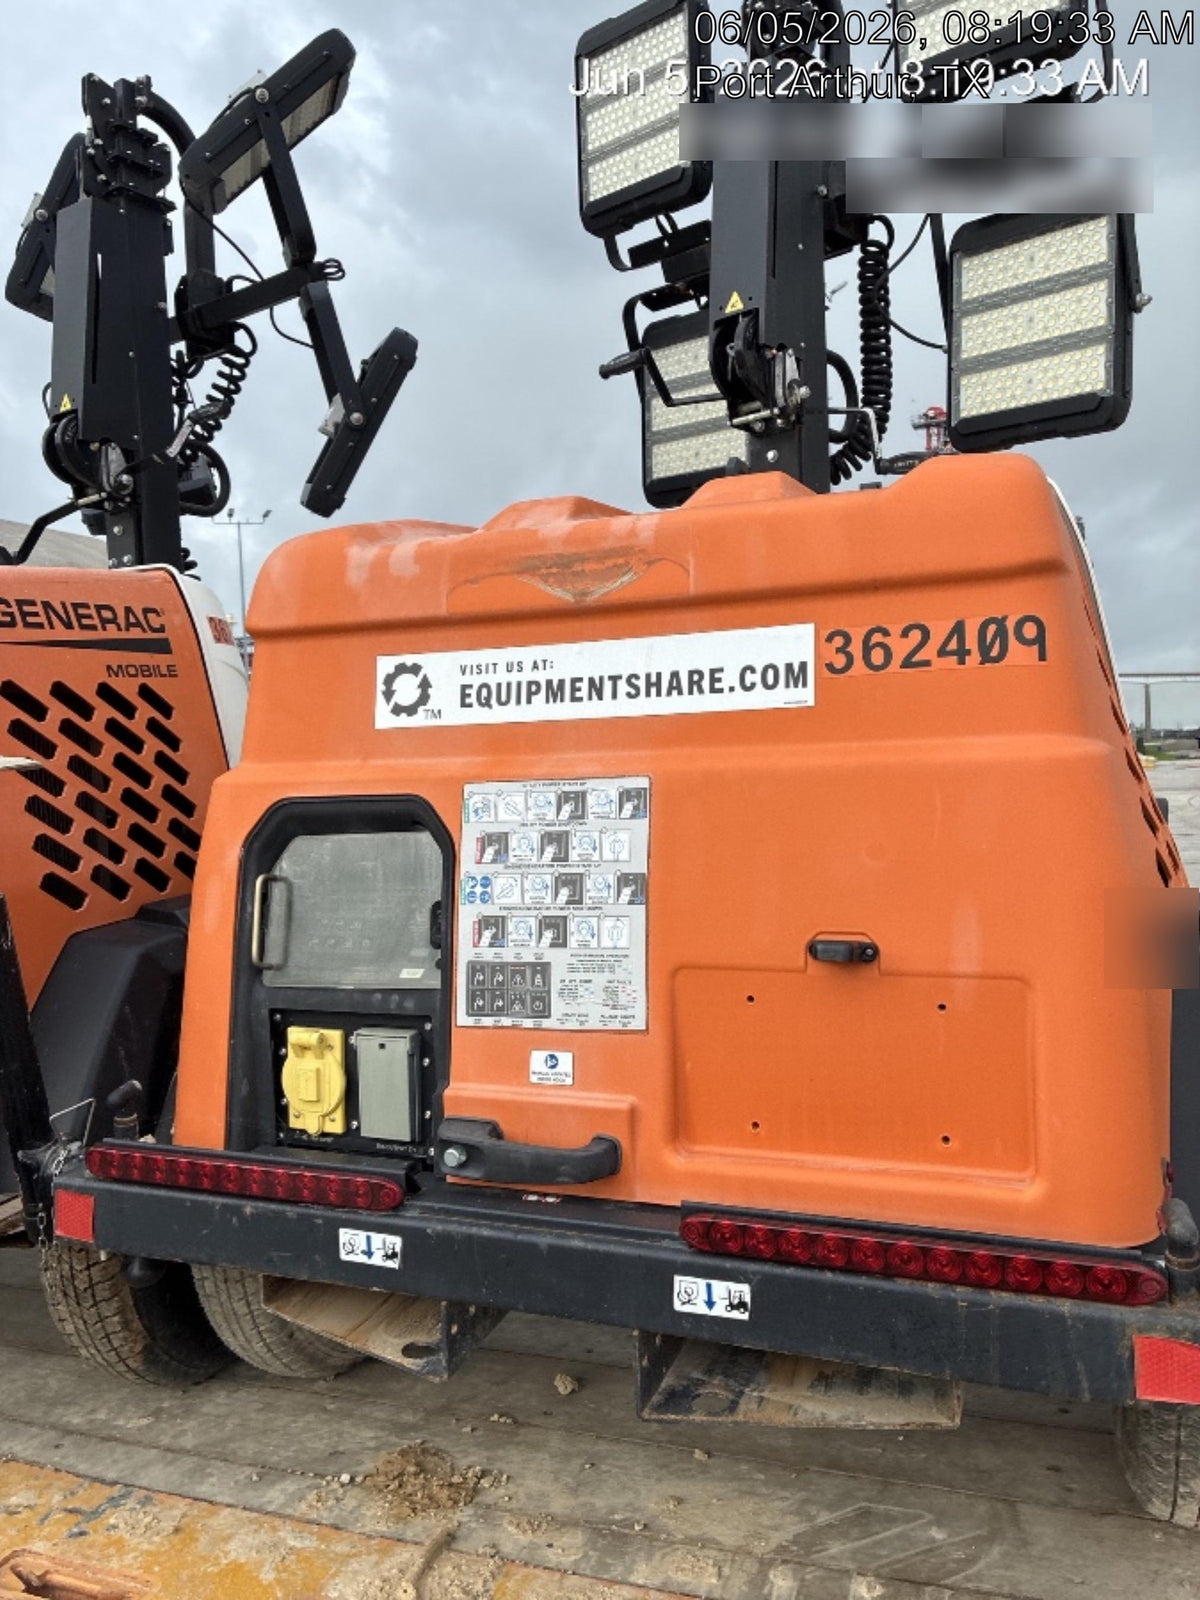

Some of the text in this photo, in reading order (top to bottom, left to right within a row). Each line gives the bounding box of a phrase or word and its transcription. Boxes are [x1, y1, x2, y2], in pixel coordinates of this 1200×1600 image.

[0, 597, 166, 634] GENERAC
[106, 664, 179, 678] MOBILE
[460, 658, 554, 677] VISIT US AT:
[460, 660, 808, 710] EQUIPMENTSHARE.COM
[422, 708, 442, 719] TM
